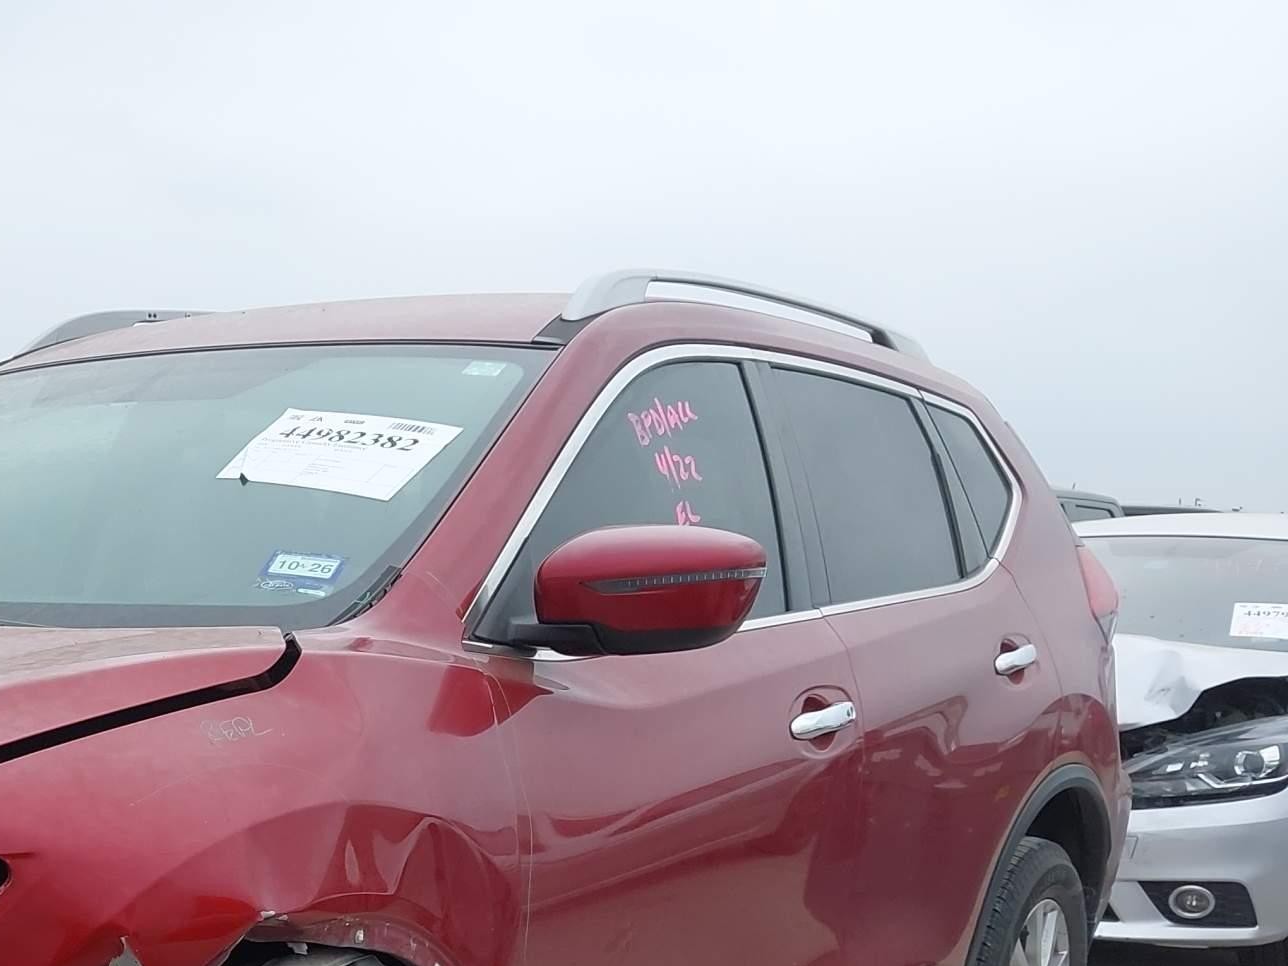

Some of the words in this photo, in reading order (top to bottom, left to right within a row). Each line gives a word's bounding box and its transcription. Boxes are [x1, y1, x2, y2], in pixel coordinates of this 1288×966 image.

[279, 426, 420, 452] 44982382
[655, 446, 703, 489] 4/22
[278, 560, 300, 571] 10
[308, 563, 334, 574] 26
